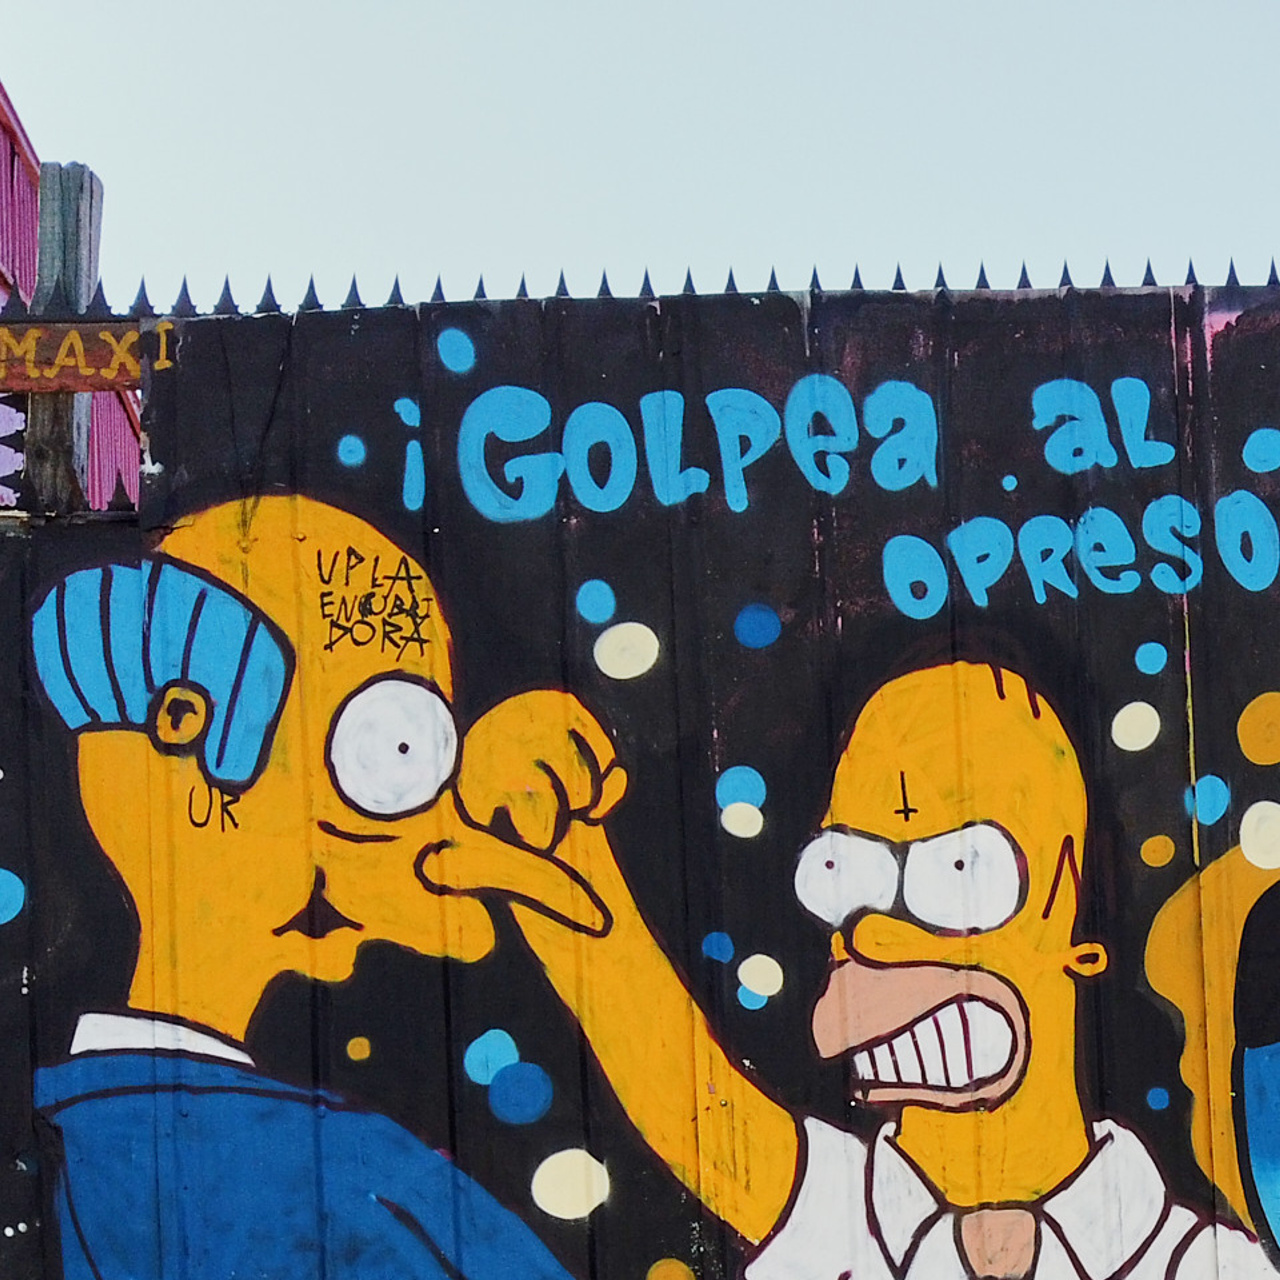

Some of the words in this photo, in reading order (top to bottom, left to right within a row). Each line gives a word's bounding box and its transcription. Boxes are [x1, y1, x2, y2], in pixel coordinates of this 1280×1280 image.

[317, 545, 366, 587] UP
[371, 555, 423, 598] LA
[323, 617, 432, 663] DORA
